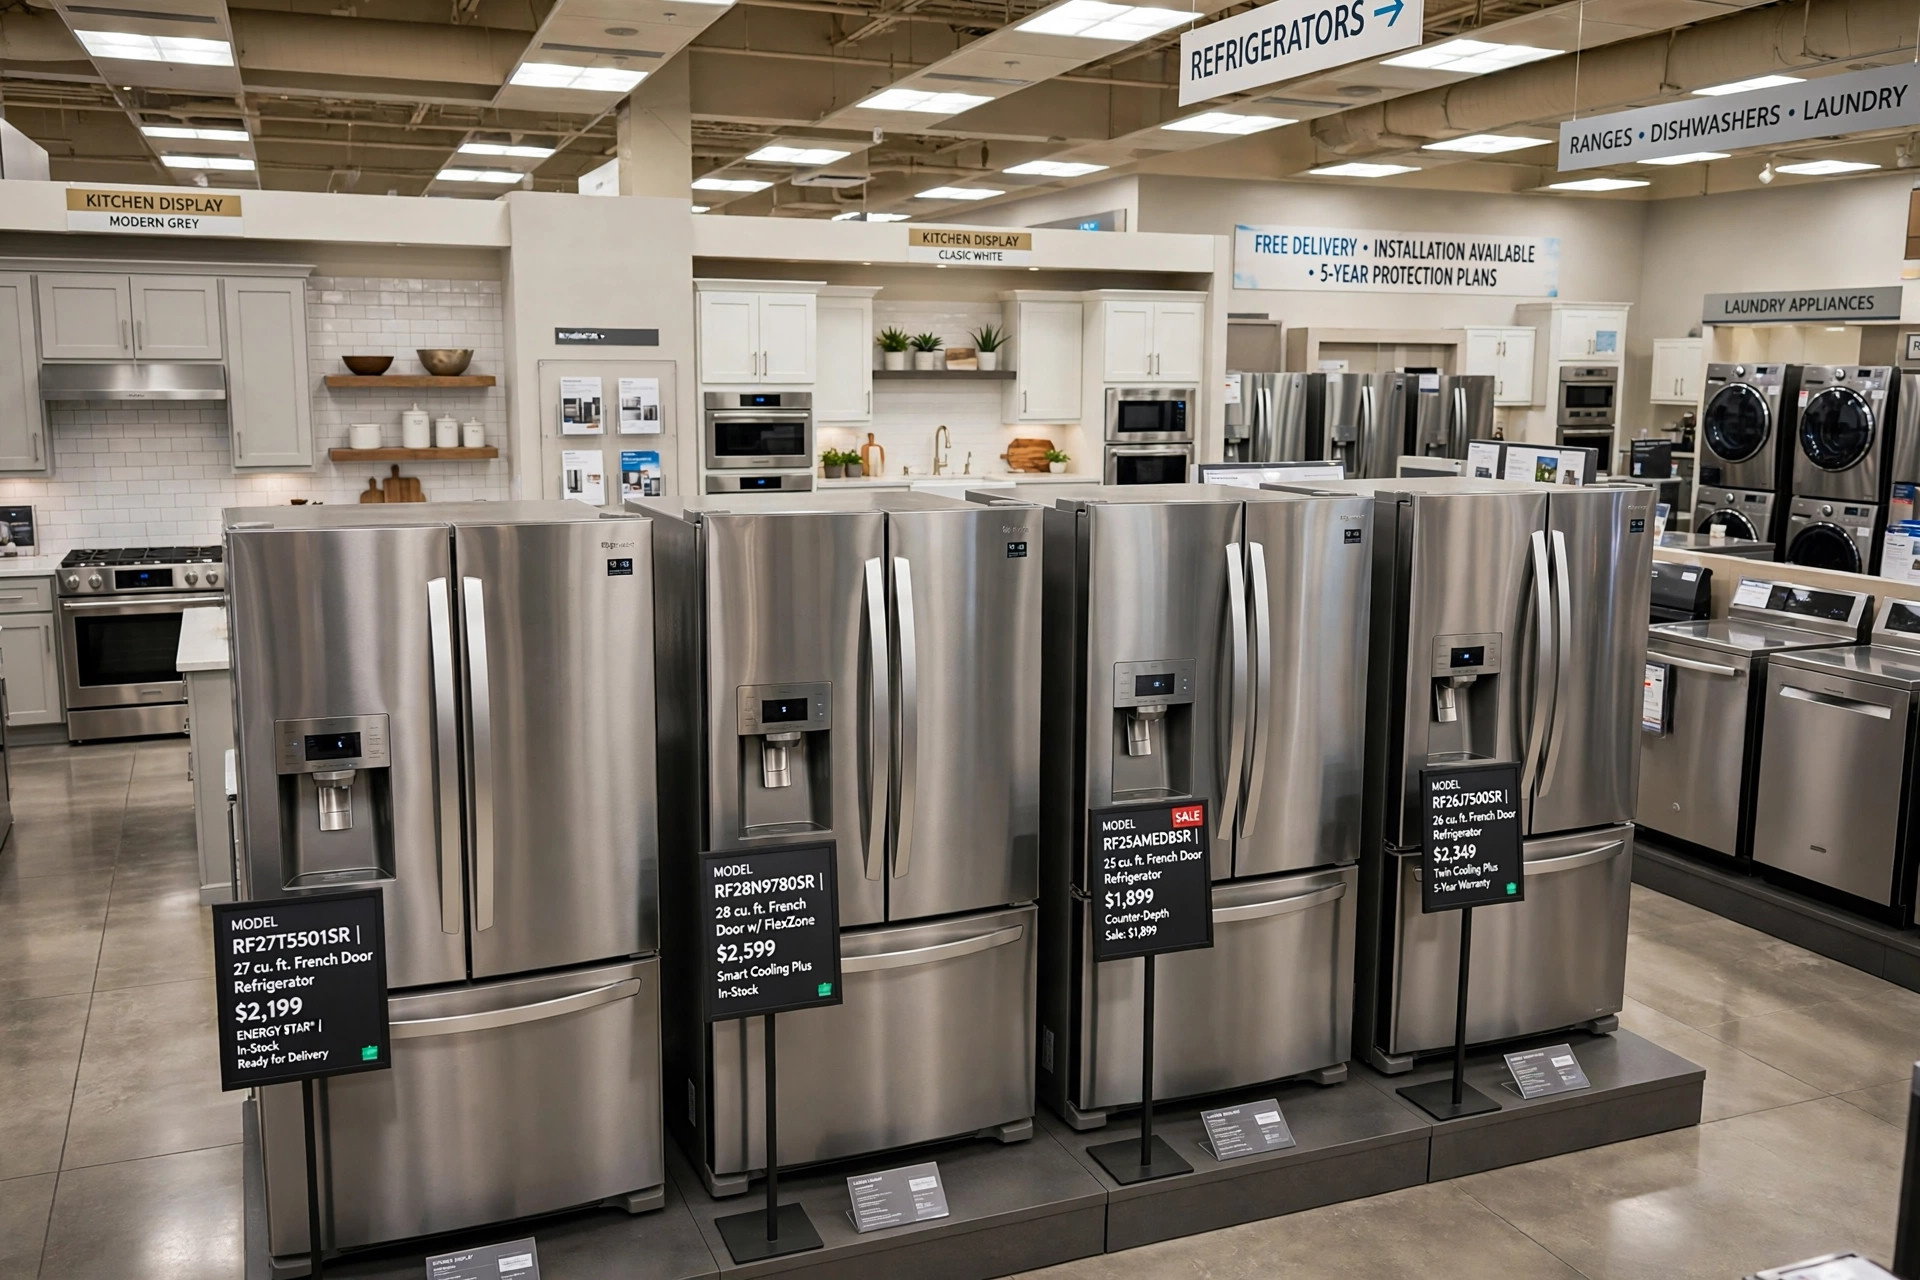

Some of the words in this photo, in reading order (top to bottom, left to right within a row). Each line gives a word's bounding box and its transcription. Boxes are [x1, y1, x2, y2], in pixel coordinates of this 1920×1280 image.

[1191, 0, 1365, 81] REFRIGERATORS
[1569, 128, 1633, 154] RANGES
[1650, 104, 1781, 143] DISHWASHERS
[1803, 84, 1909, 121] LAUNDRY
[86, 194, 154, 209] KITCHEN
[160, 197, 223, 212] DISPLAY
[110, 216, 164, 228] MODERN
[168, 218, 199, 229] GREY
[922, 232, 970, 245] KITCHEN
[974, 235, 1019, 247] DISPLAY
[1255, 234, 1288, 254] FREE
[1292, 236, 1357, 257] DELIVERY
[1374, 239, 1465, 261] INSTALLATION
[1468, 243, 1535, 263] AVAILABLE
[939, 250, 971, 260] CLASIC
[974, 251, 1003, 261] WHITE
[1320, 263, 1369, 284] 5-YEAR
[1372, 266, 1452, 286] PROTECTION
[1456, 267, 1497, 287] PLANS
[1724, 298, 1785, 314] LAUNDRY
[1789, 295, 1875, 313] APPLIANCES
[1432, 780, 1461, 791] MODEL
[1432, 790, 1502, 809] RF26J7500SR
[1102, 819, 1136, 831] MODEL
[1175, 810, 1200, 823] SALE
[1432, 815, 1444, 826] 26
[1445, 815, 1457, 825] cu.
[1459, 812, 1468, 823] ft.
[1469, 810, 1495, 822] French
[1497, 809, 1516, 819] Door
[1103, 829, 1191, 851] RF25AMEDBSR
[1433, 828, 1482, 841] Refrigerator
[1104, 857, 1117, 869] 25
[1118, 858, 1132, 868] cu.
[1135, 854, 1145, 866] ft.
[1147, 850, 1177, 865] French
[1180, 850, 1203, 861] Door
[1433, 844, 1476, 863] $2,349
[713, 864, 753, 877] MODEL
[1104, 869, 1162, 885] Refrigerator
[1433, 867, 1452, 878] Twin
[1452, 863, 1481, 876] Cooling
[1482, 862, 1499, 872] Plus
[714, 874, 815, 898] RF28N9780SR
[1433, 881, 1457, 893] 5-Year
[1458, 879, 1490, 890] Warranty
[715, 906, 731, 919] 28
[734, 906, 751, 917] cu.
[753, 902, 766, 915] ft.
[768, 897, 806, 913] French
[1104, 888, 1154, 909] $1,899
[231, 916, 278, 931] MODEL
[716, 923, 745, 937] Door
[747, 919, 762, 934] w/
[764, 915, 815, 931] FlexZone
[1105, 908, 1169, 925] Counter-Depth
[232, 926, 350, 955] RF27T5501SR
[1105, 928, 1126, 941] Sale:
[1128, 925, 1157, 939] $1,899
[716, 939, 776, 964] $2,599
[233, 962, 250, 975] 27
[253, 962, 273, 974] cu.
[276, 957, 291, 971] ft.
[294, 952, 338, 969] French
[341, 951, 373, 964] Door
[717, 969, 748, 982] Smart
[750, 963, 789, 977] Cooling
[791, 960, 812, 972] Plus
[234, 975, 315, 994] Refrigerator
[718, 984, 759, 998] In-Stock
[235, 996, 303, 1024] $2,199
[236, 1025, 281, 1041] ENERGY
[237, 1041, 280, 1055] In-Stock
[238, 1056, 268, 1069] Ready
[271, 1054, 286, 1065] for
[288, 1050, 329, 1062] Delivery
